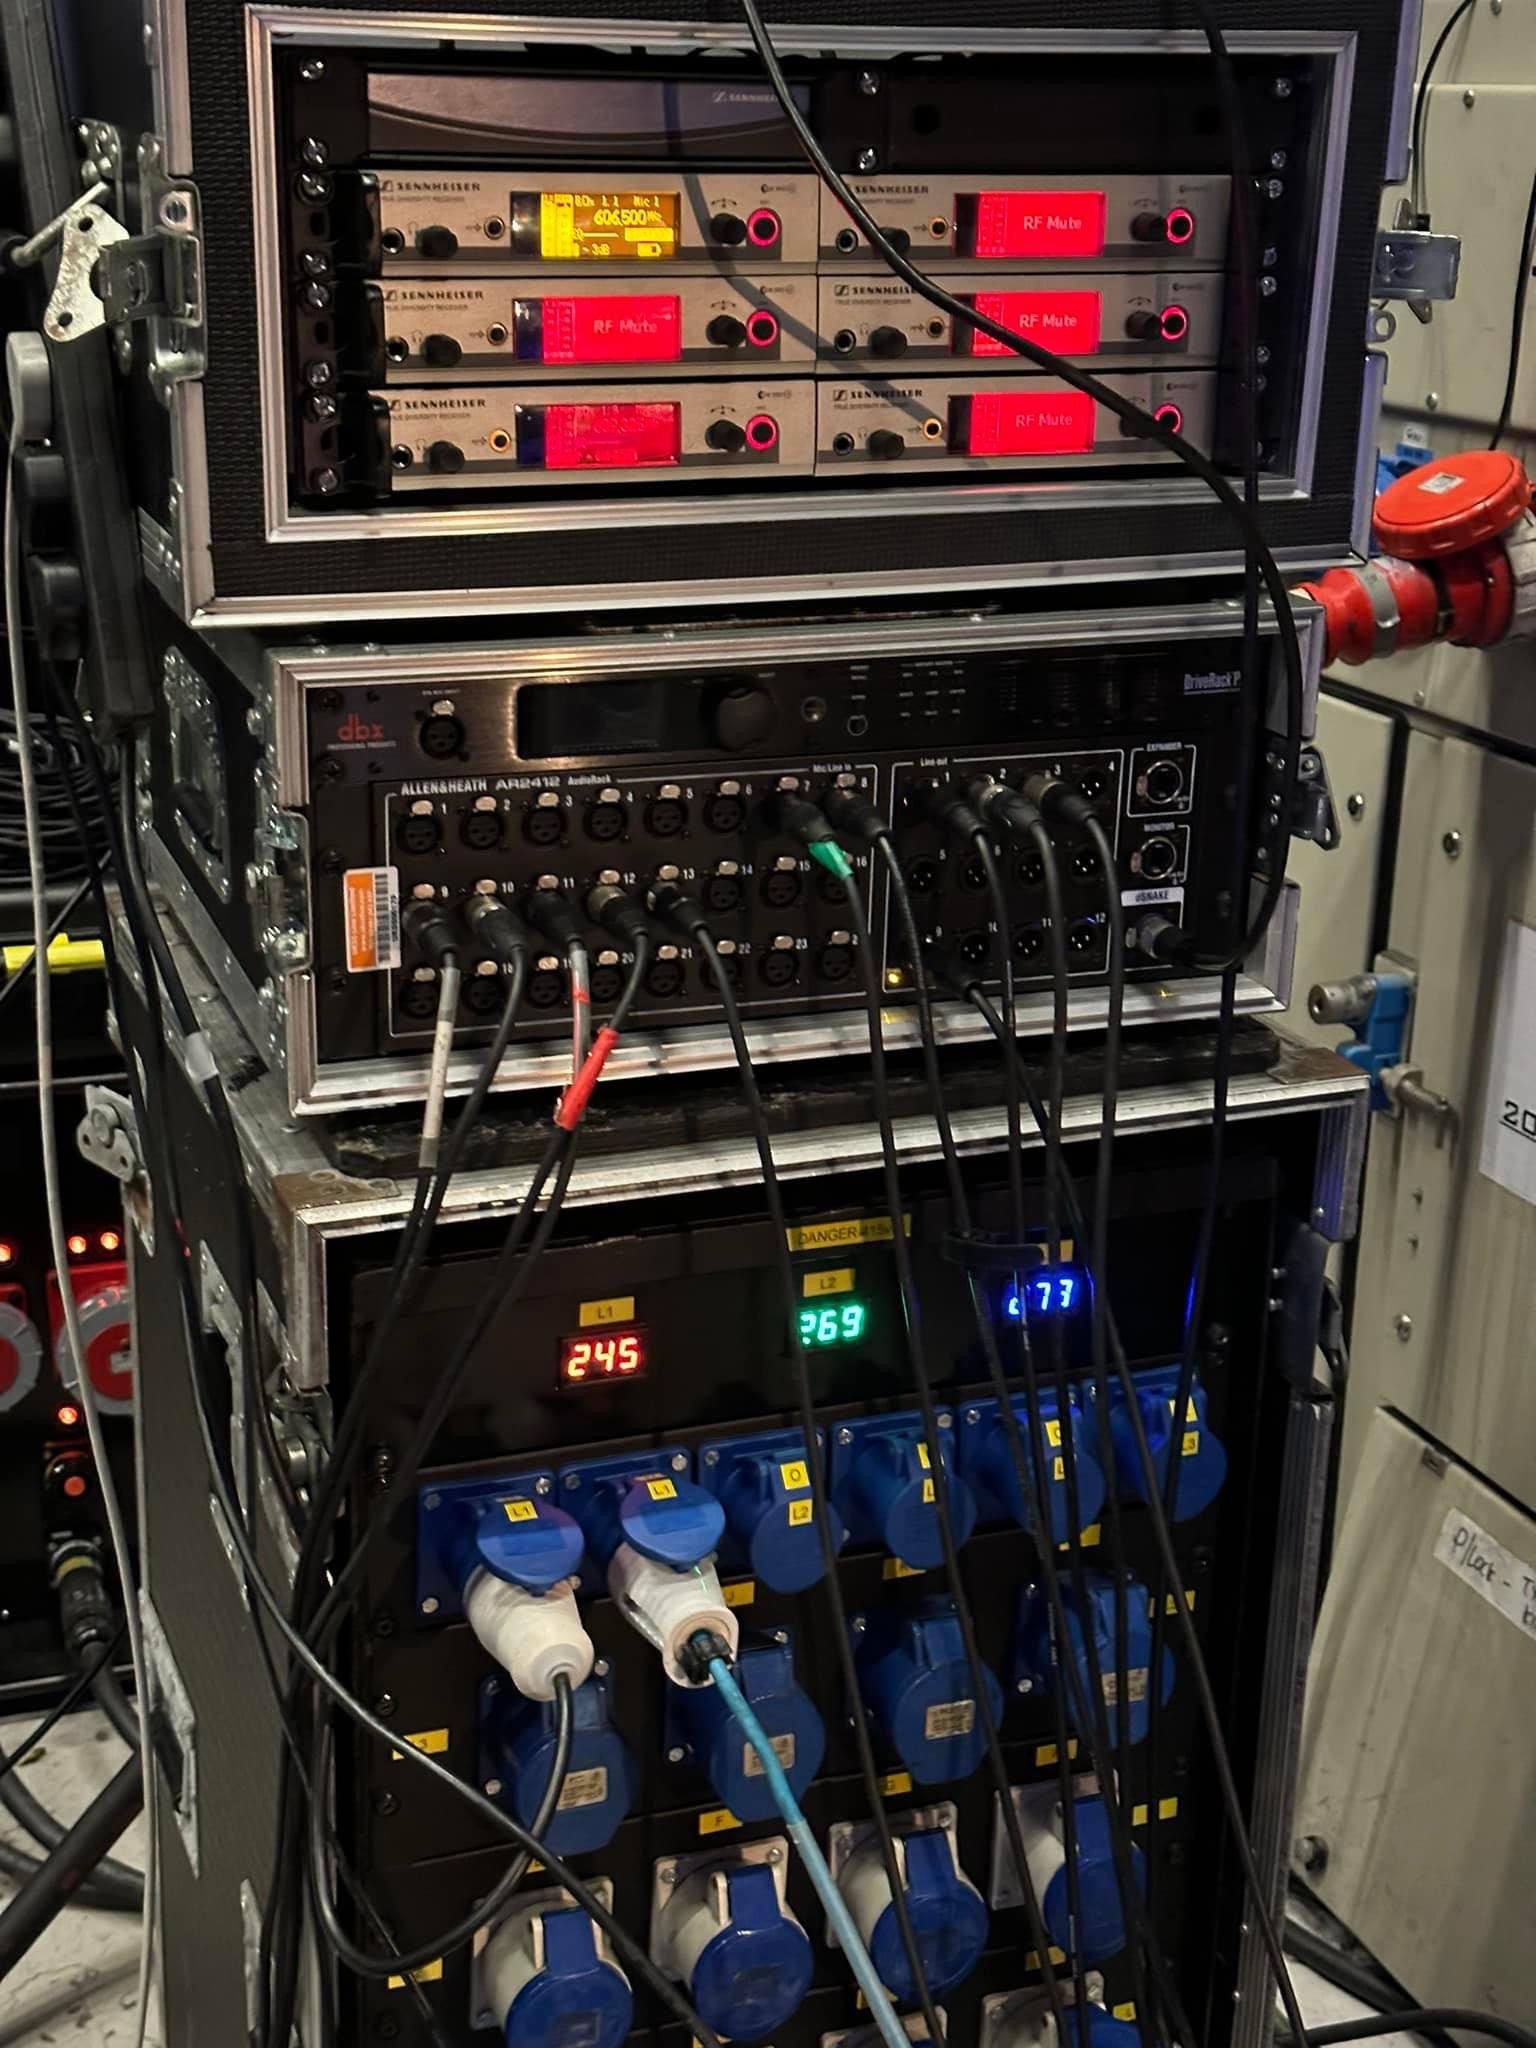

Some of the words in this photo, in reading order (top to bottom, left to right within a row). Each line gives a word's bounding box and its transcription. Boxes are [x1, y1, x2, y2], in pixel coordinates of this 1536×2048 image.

[397, 182, 481, 192] SENNHEISER
[855, 185, 929, 195] SENNHEISER
[1023, 215, 1043, 230] RF
[1046, 214, 1083, 230] Mute
[402, 290, 484, 300] SENNHEISER
[593, 319, 614, 336] RF
[619, 318, 658, 334] Mute
[1019, 314, 1039, 328] RF
[1042, 313, 1078, 328] Mute
[404, 399, 486, 410] SENNHEISER
[1015, 414, 1035, 428] RF
[1038, 413, 1073, 427] Mute
[338, 713, 385, 741] dbx
[401, 777, 487, 796] ALLEN&HEATH
[496, 776, 560, 790] AR2412
[800, 1226, 858, 1245] DANGER
[820, 1276, 837, 1290] L2
[598, 1305, 613, 1319] L1
[568, 1337, 638, 1377] 245
[653, 1485, 670, 1495] L1
[513, 1506, 530, 1516] L1
[793, 1506, 809, 1521] L2
